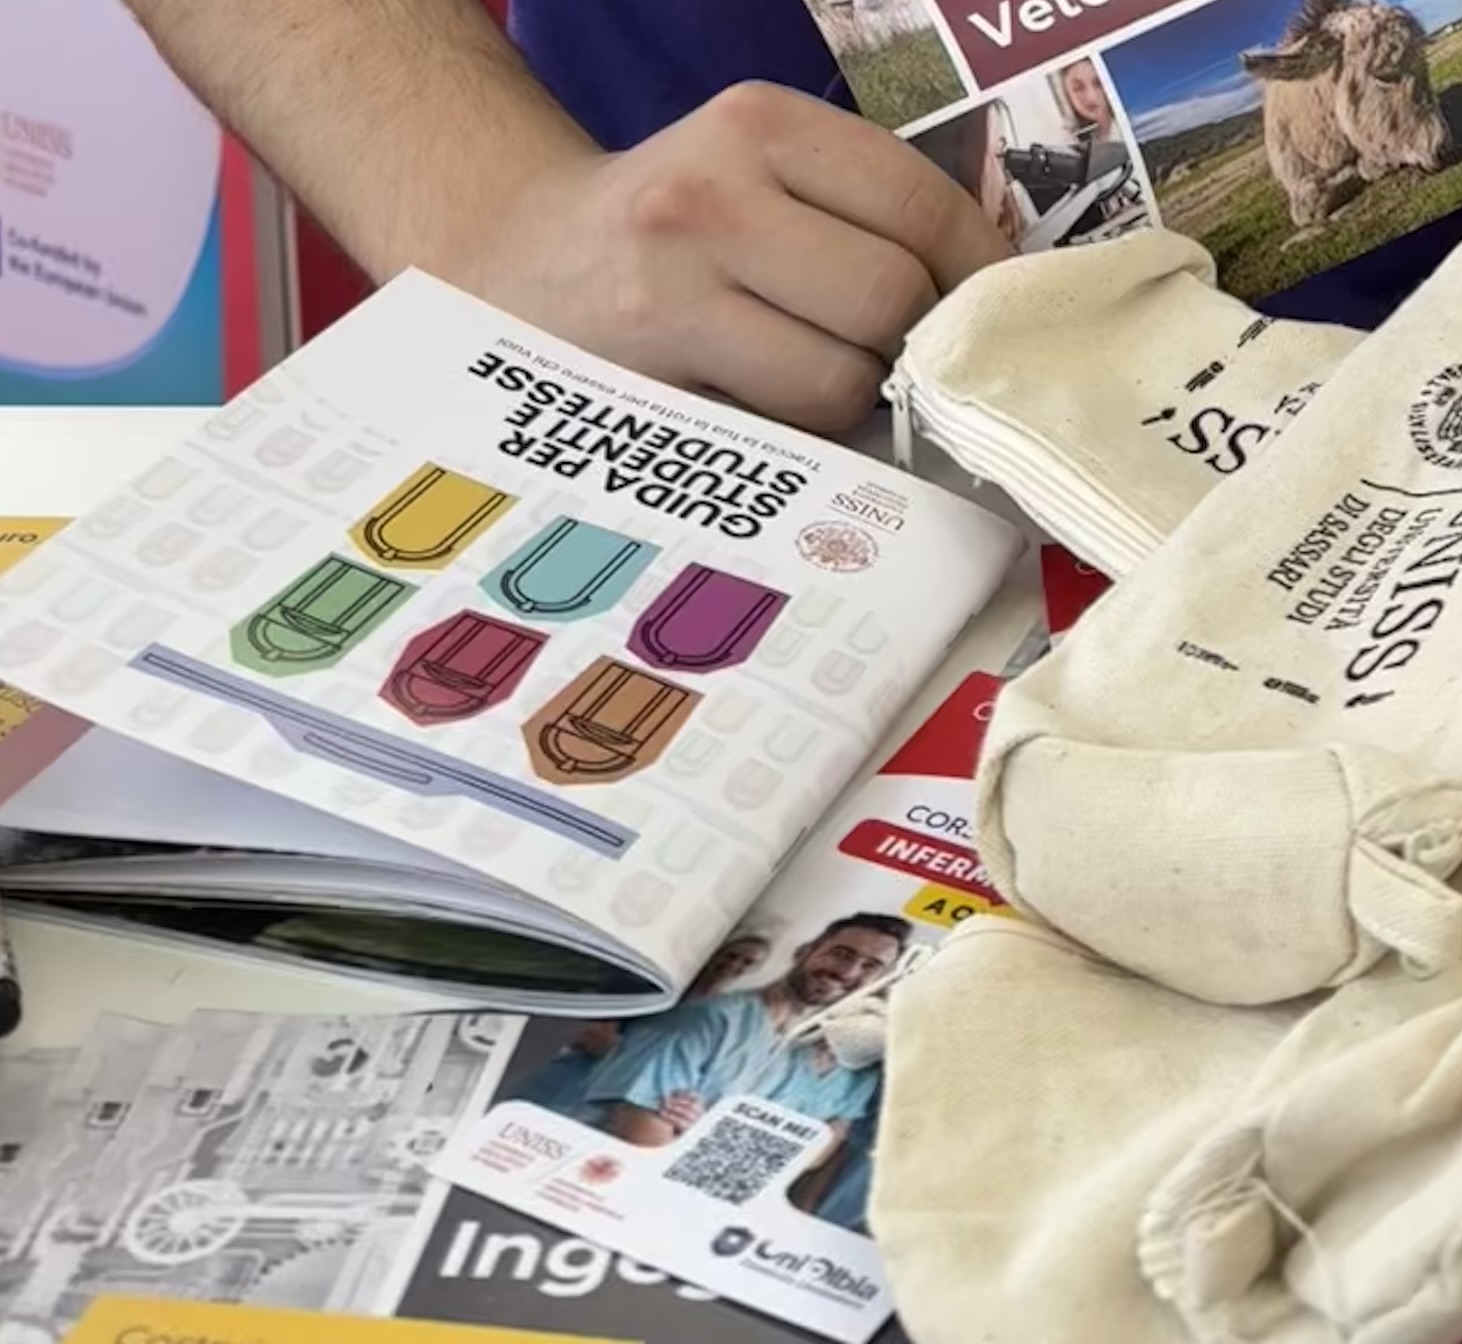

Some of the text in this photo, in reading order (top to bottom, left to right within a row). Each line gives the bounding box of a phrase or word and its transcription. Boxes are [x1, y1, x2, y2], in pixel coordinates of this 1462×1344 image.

[467, 351, 808, 496] STUDENTESSE
[504, 402, 544, 429] E
[497, 429, 763, 540] GUIDA PER
[543, 419, 788, 518] STUDENTI
[831, 492, 905, 531] UNISS
[1267, 492, 1372, 592] DI SASSARI
[1340, 506, 1408, 566] DEGLI
[1285, 565, 1357, 626] STUDI
